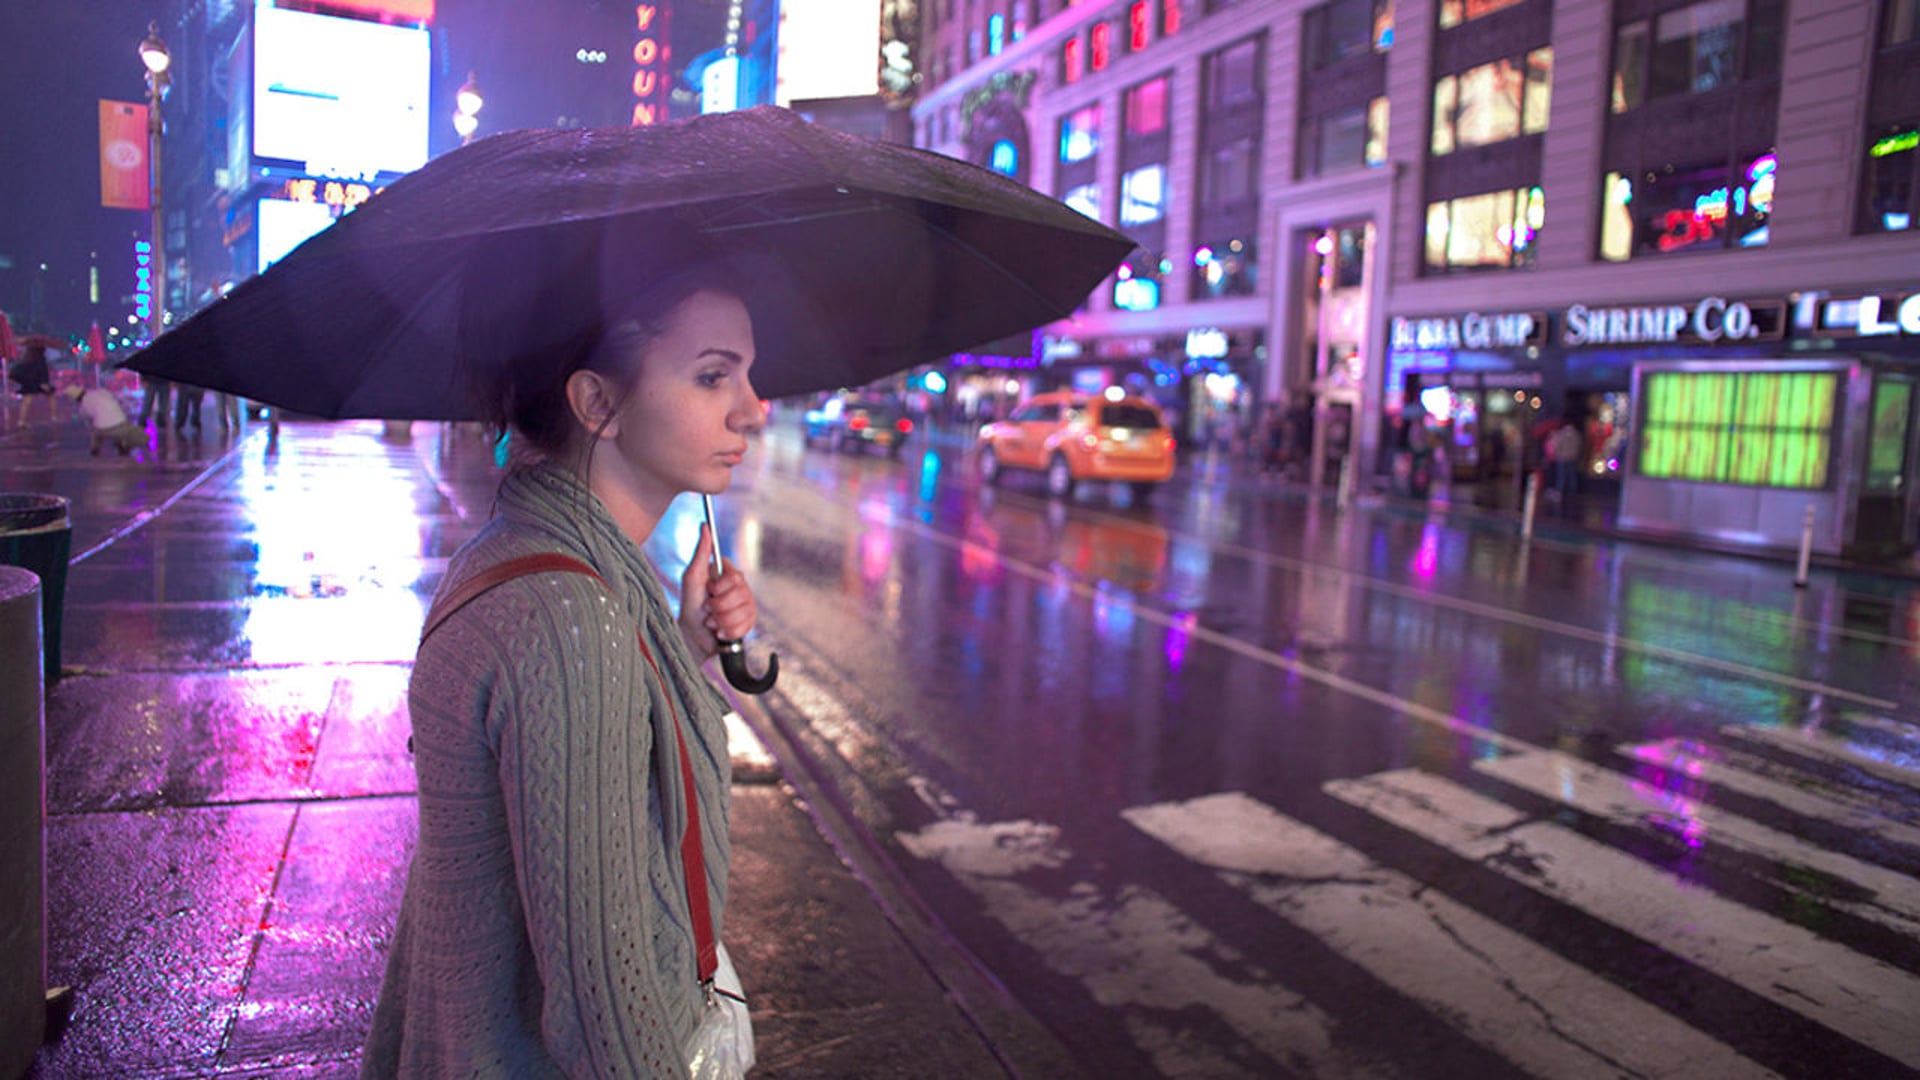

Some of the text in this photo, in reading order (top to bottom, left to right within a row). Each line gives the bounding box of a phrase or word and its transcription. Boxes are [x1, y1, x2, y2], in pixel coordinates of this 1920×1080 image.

[1462, 312, 1534, 348] GUMP
[1564, 304, 1687, 345] SHRIMP
[1693, 297, 1759, 341] CO.
